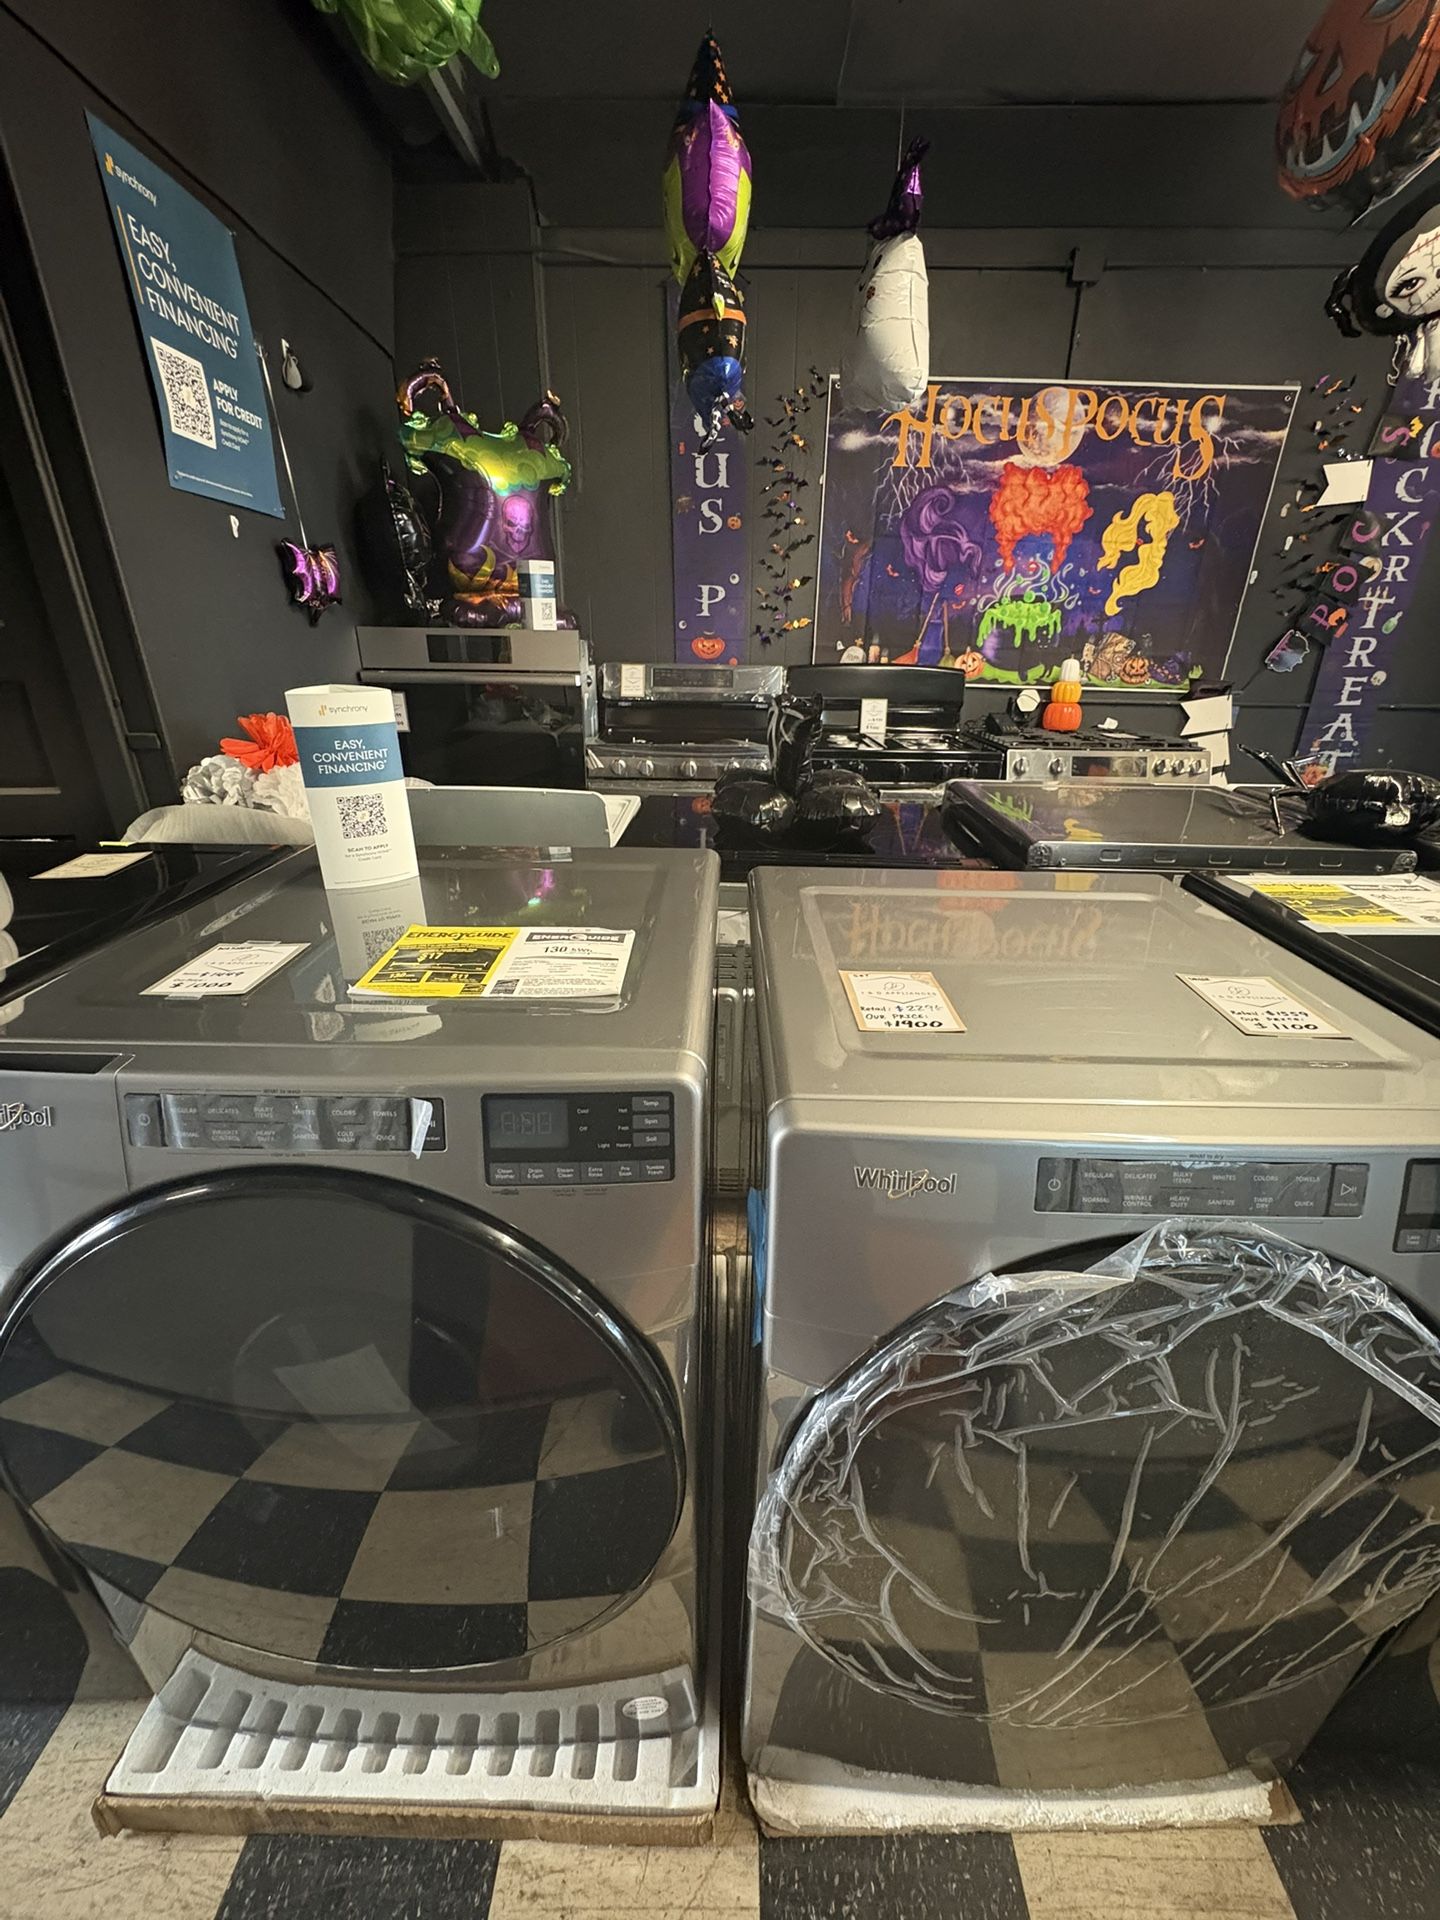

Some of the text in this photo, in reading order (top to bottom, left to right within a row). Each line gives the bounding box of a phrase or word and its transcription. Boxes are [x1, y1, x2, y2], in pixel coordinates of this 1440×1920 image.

[127, 213, 177, 272] EASY,
[138, 252, 239, 336] CONVENIENT
[213, 377, 238, 401] APPLY
[215, 395, 263, 430] FOR CREDIT
[329, 704, 368, 714] synchrony
[334, 738, 366, 751] EASY,
[312, 747, 388, 764] CONVENIENT
[884, 1020, 943, 1028] $1900
[854, 1166, 958, 1199] Whirlpool
[1212, 1174, 1237, 1182] WHITES
